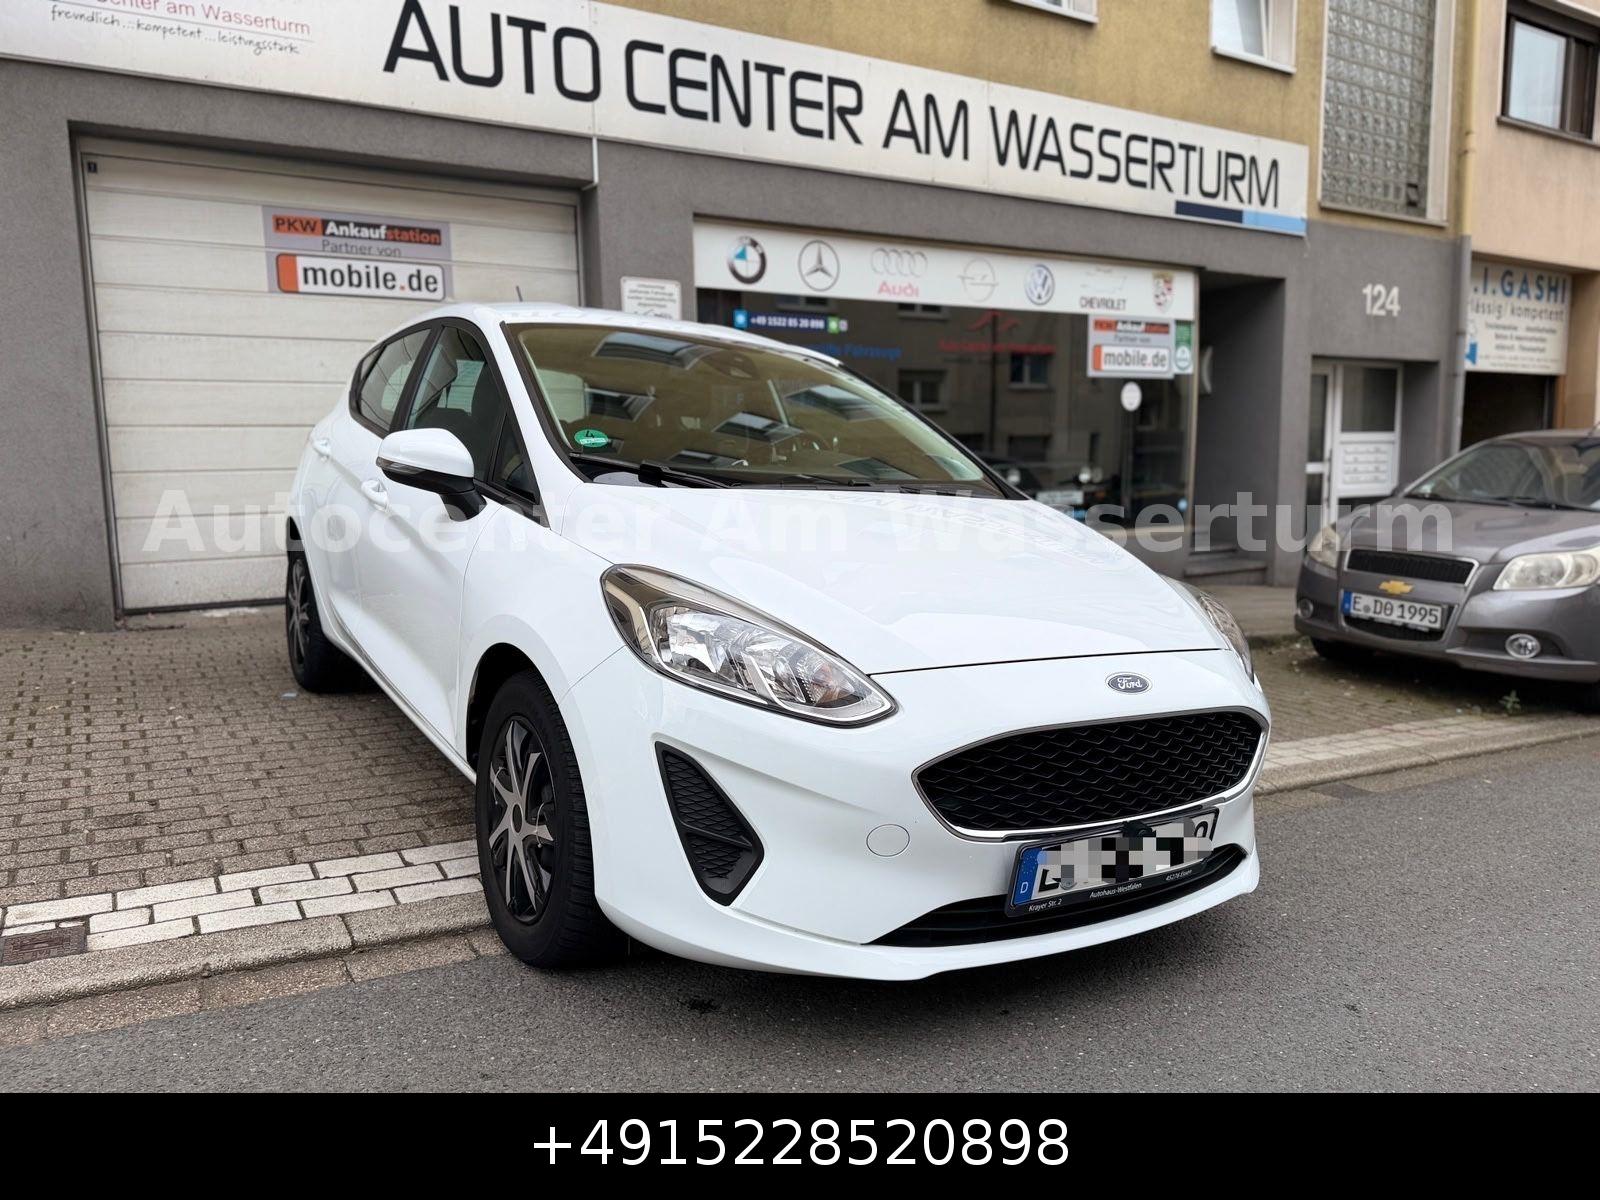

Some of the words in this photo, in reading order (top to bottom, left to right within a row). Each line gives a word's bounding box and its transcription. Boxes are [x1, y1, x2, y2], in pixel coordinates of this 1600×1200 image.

[167, 1, 195, 16] am
[201, 4, 311, 35] Wasserturm
[383, 0, 602, 102] AUTO
[625, 39, 864, 146] CENTER
[882, 88, 969, 161] AM
[989, 104, 1280, 209] WASSERTURM
[275, 217, 318, 233] PKW
[325, 221, 442, 244] Ankaufstation
[322, 239, 373, 256] Partner
[376, 246, 402, 258] von
[303, 263, 438, 293] mobile.de
[878, 281, 919, 298] Audi
[1080, 295, 1127, 311] CHEVROLET
[1362, 283, 1401, 317] 124
[1104, 349, 1168, 368] mobile.de
[1352, 595, 1362, 612] E
[1397, 603, 1440, 625] 1995
[1117, 677, 1143, 690] Ford
[1020, 881, 1029, 894] D
[1089, 882, 1142, 898] Autohaus-Westfalen
